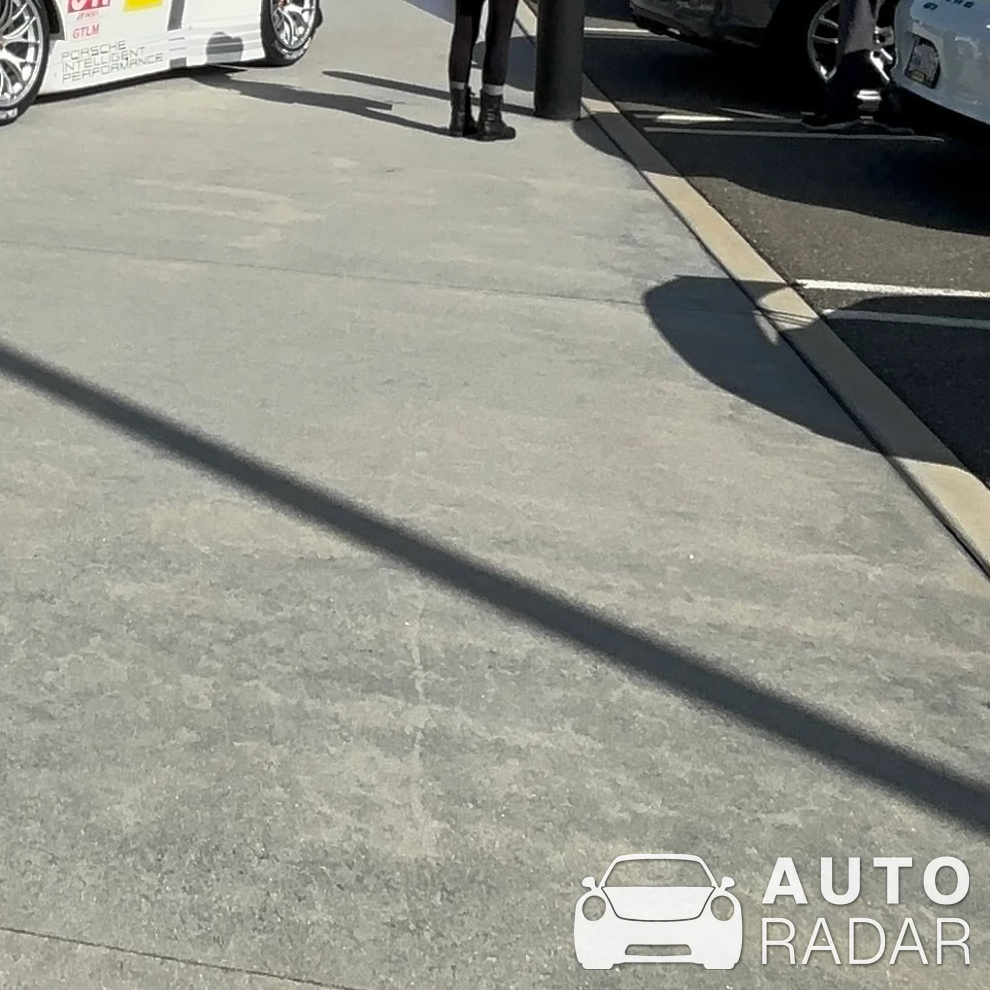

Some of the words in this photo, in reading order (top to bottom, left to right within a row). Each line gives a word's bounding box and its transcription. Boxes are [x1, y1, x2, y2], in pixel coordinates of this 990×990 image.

[72, 24, 100, 39] GTLM
[62, 40, 127, 60] PORSCHE
[62, 46, 145, 73] INTELLIGENT
[62, 52, 163, 83] PERFORMANCE
